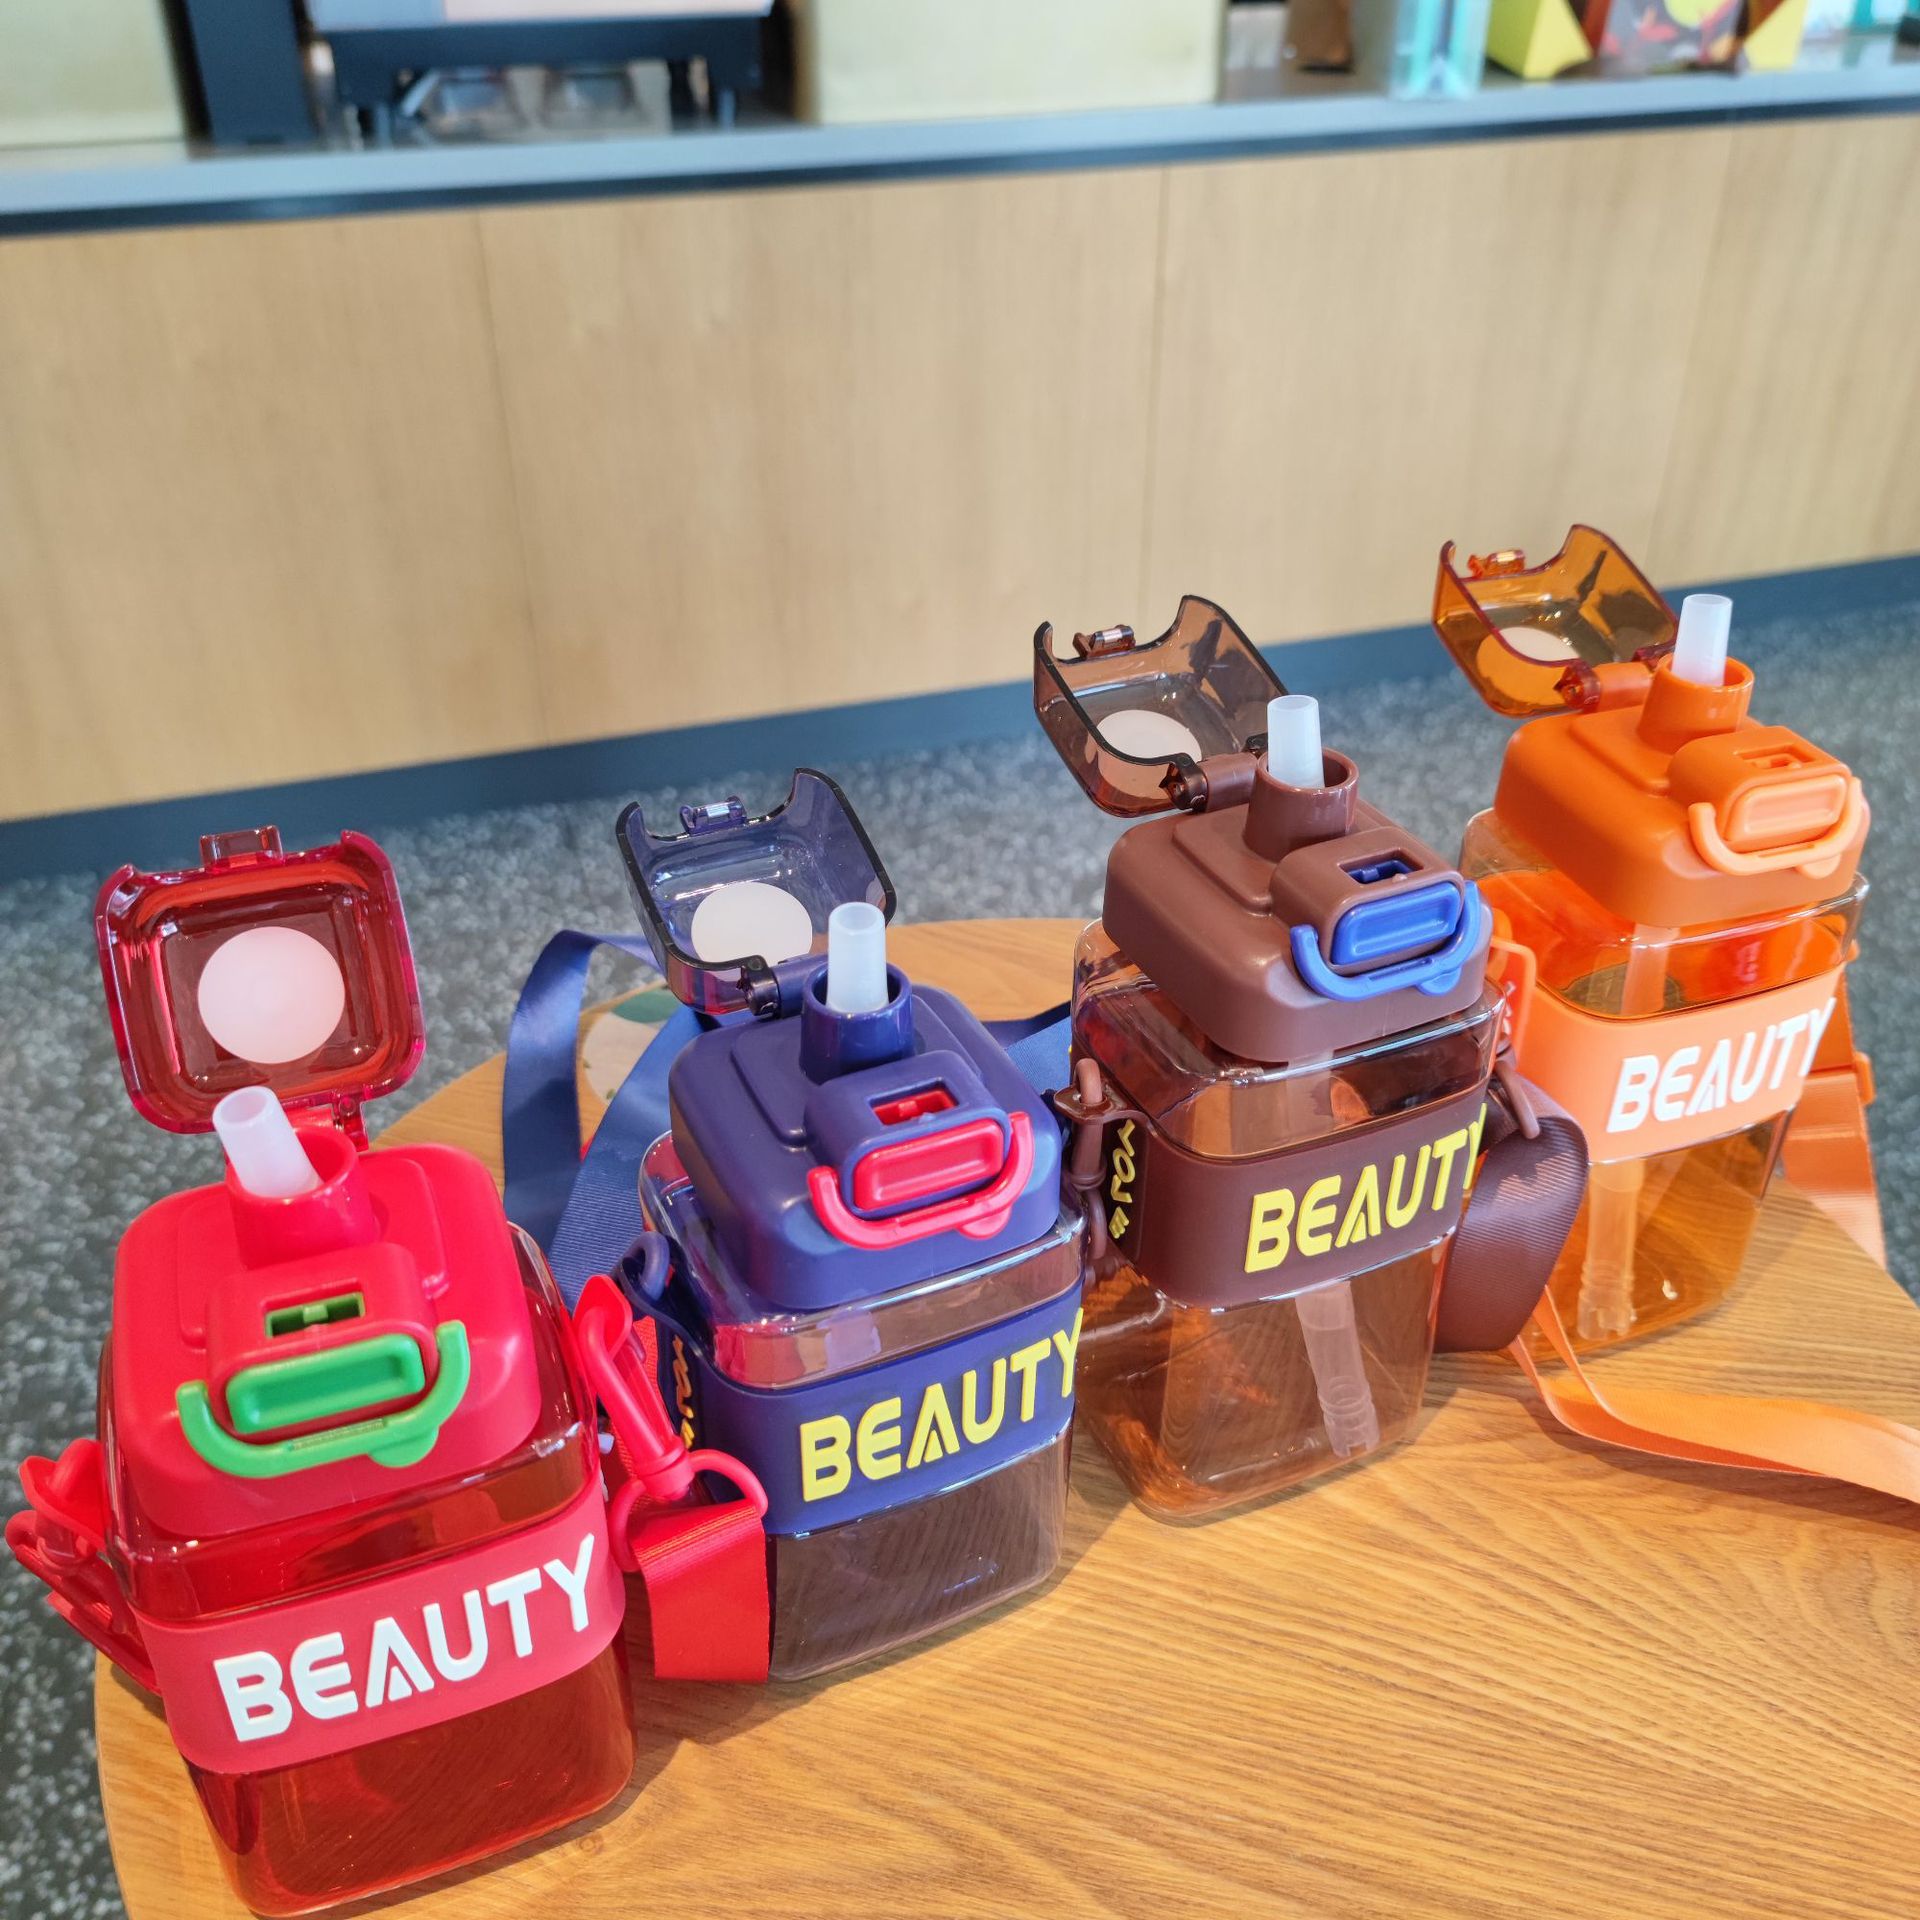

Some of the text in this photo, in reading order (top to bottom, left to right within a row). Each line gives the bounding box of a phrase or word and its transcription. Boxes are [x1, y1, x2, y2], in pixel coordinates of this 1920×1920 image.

[1606, 996, 1837, 1134] BEAUTY
[1244, 1102, 1488, 1274] BEAUTY
[800, 1306, 1085, 1502] BEAUTY
[213, 1533, 595, 1742] BEAUTY
